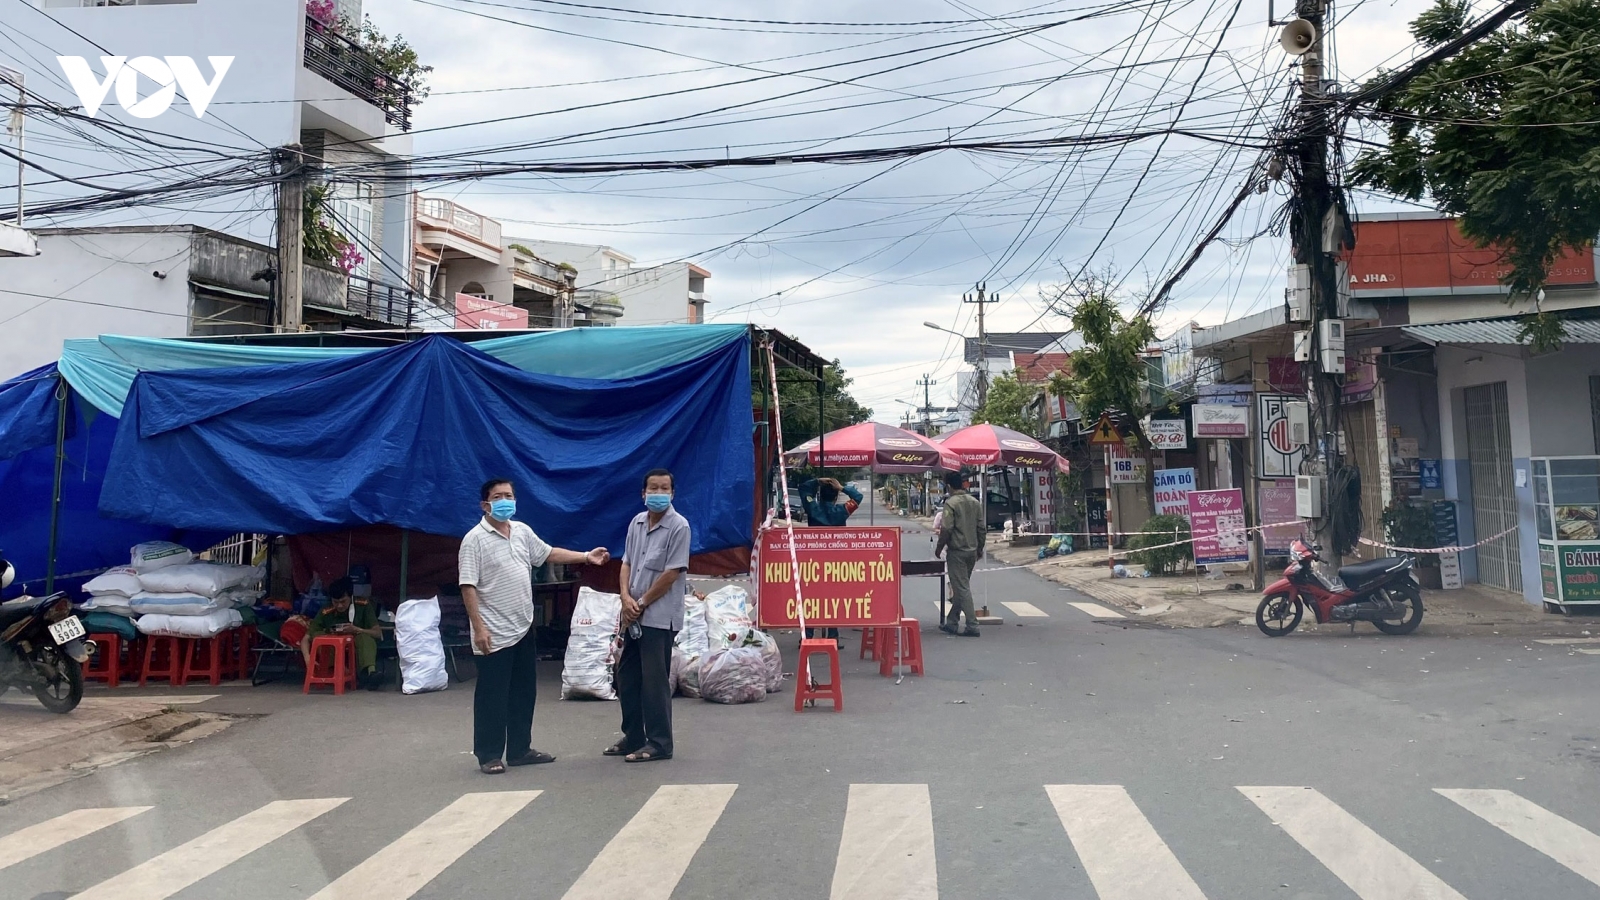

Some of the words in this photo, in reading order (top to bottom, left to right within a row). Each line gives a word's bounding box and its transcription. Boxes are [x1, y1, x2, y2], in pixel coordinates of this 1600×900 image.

[1168, 432, 1184, 443] Bi
[892, 453, 924, 462] Coffee
[1014, 456, 1043, 465] Coffee
[1114, 461, 1132, 471] 16B
[1155, 487, 1192, 503] HOÀN
[1197, 493, 1233, 508] Cherry
[1162, 504, 1190, 516] MINH
[803, 532, 819, 540] NHÂN
[820, 532, 832, 540] DÂN
[833, 532, 857, 540] PHƯỜNG
[858, 532, 870, 540] TÂN
[871, 532, 882, 540] LẬP
[807, 541, 827, 549] PHÒNG
[828, 541, 848, 549] CHỐNG
[851, 541, 866, 549] DỊCH
[867, 541, 893, 549] COVID-19
[1565, 549, 1600, 567] BÁNH
[765, 562, 791, 583] KHU
[824, 561, 866, 583] PHONG
[868, 553, 894, 582] TỎA
[824, 598, 840, 619] LY
[844, 598, 852, 619] Y
[856, 589, 874, 619] TẾ
[58, 627, 80, 642] 5903
